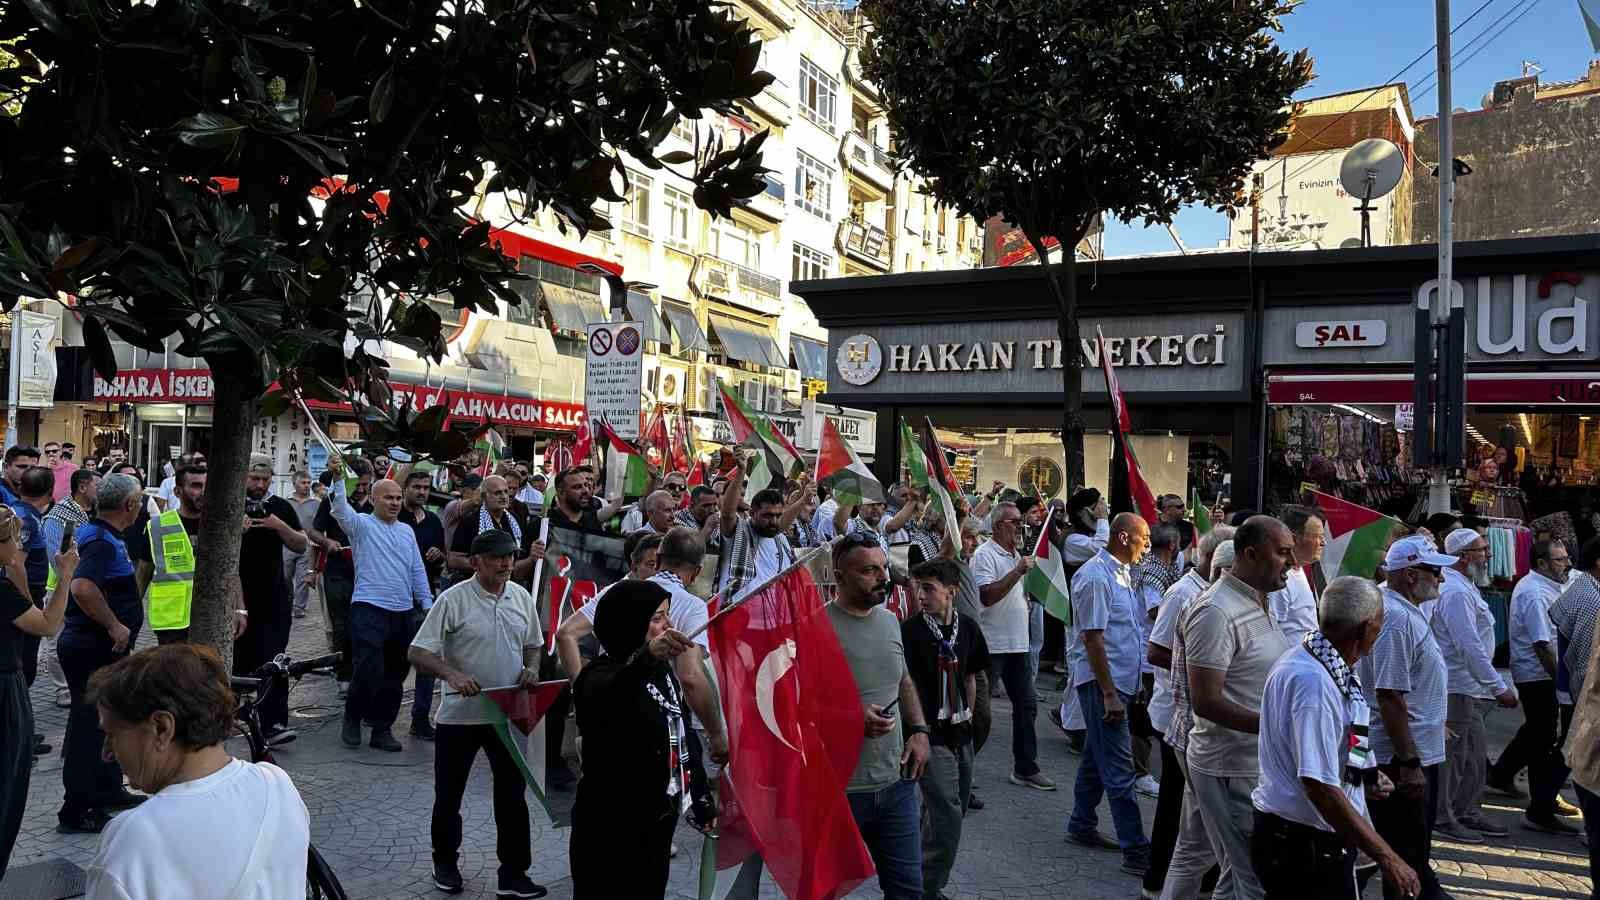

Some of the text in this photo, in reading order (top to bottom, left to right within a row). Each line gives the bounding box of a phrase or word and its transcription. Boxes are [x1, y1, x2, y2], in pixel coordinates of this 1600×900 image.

[1299, 179, 1333, 190] Evinizin
[1315, 325, 1367, 346] ŞAL
[888, 324, 1225, 372] HAKAN TNEKECİ
[94, 375, 164, 397] BUHARA
[451, 397, 542, 421] AHMACUN
